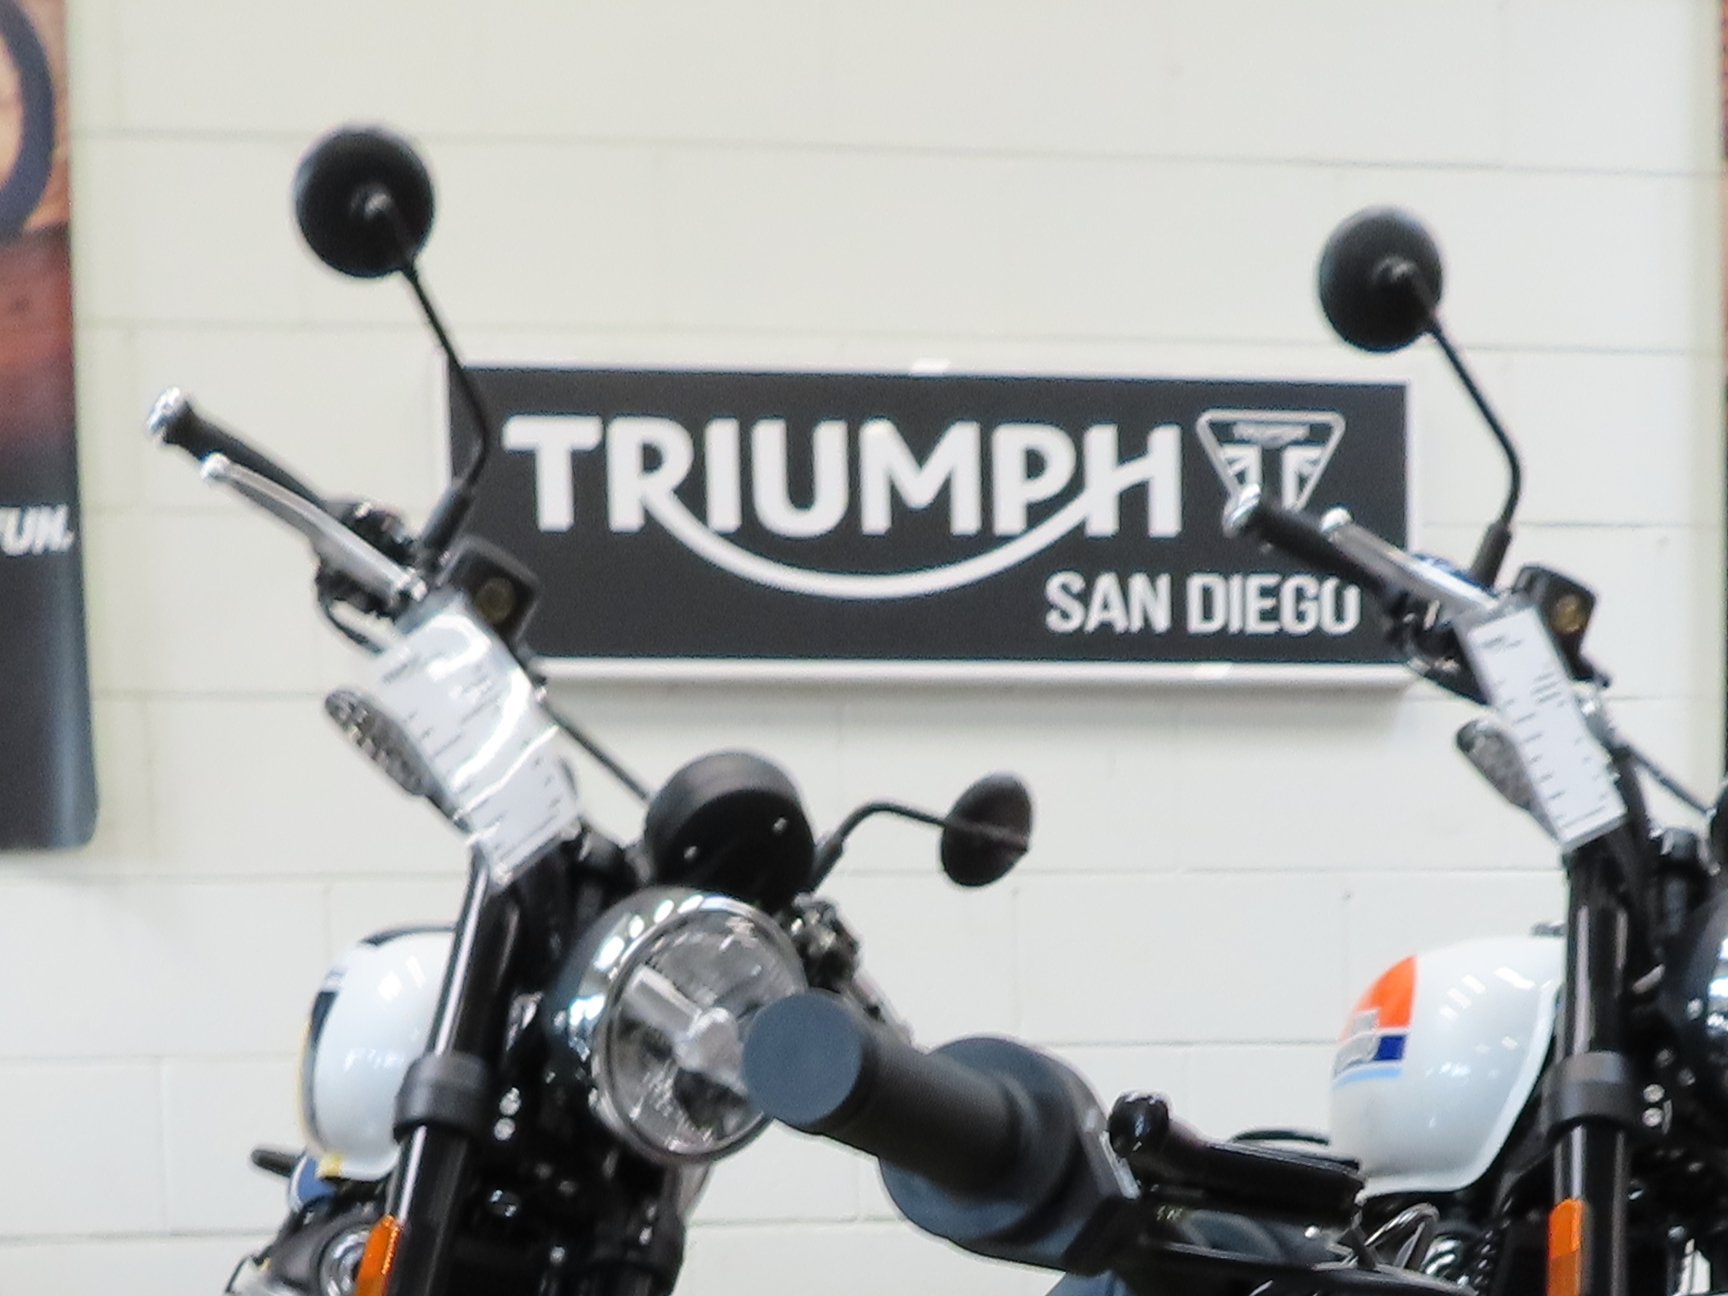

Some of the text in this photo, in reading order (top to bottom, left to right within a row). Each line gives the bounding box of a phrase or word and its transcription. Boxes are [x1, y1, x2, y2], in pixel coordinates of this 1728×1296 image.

[502, 414, 1183, 600] TRIUMPH
[1045, 570, 1361, 636] SAN DIEGO
